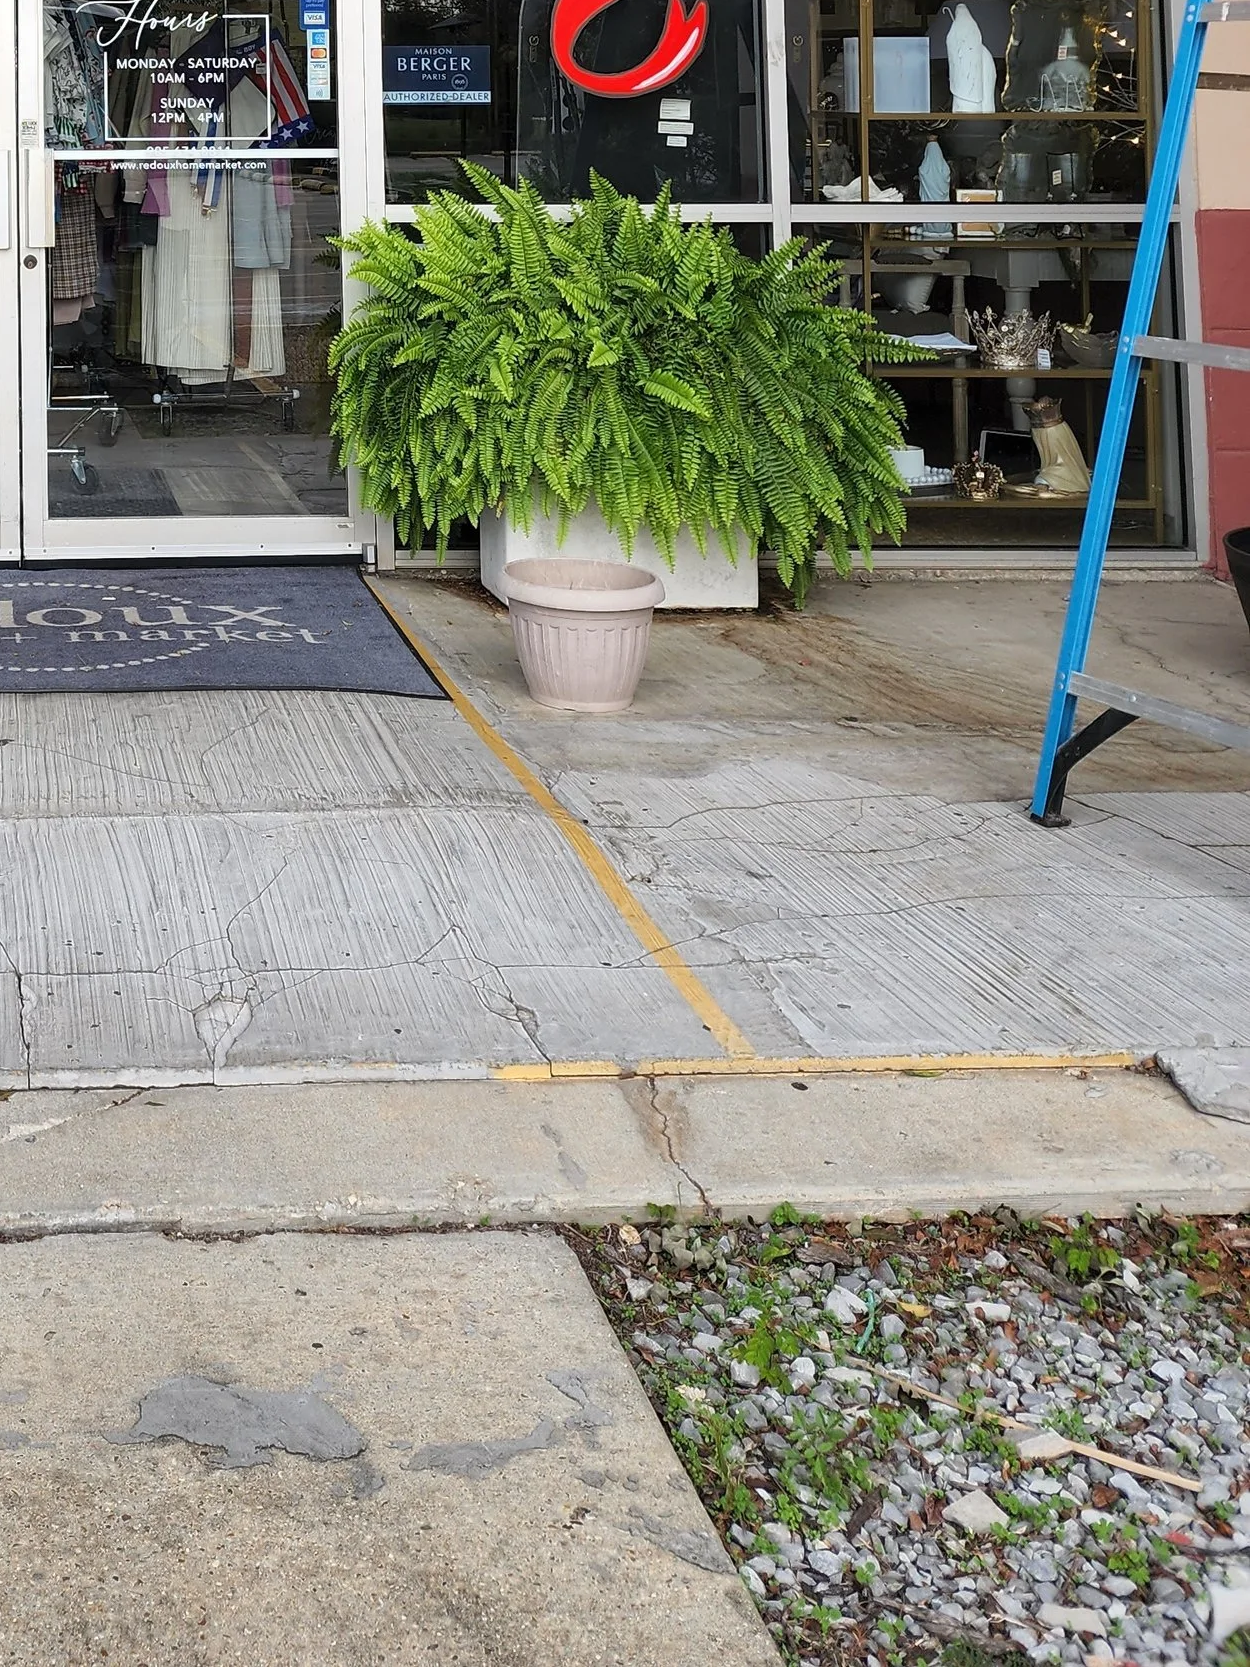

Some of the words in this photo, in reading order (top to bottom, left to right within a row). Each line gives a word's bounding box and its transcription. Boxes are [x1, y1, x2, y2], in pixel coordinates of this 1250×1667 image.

[415, 47, 452, 55] MAISON
[116, 58, 176, 69] MONDAY
[187, 57, 257, 69] SATURDAY
[397, 57, 471, 71] BERGER
[150, 72, 185, 84] 10AM
[198, 72, 225, 84] 6PM
[421, 73, 447, 81] PARIS
[160, 98, 215, 109] SUNDAY
[151, 112, 185, 124] 12PM
[197, 112, 225, 124] 4PM
[110, 160, 267, 171] www.redouxhomemarket.com
[65, 626, 326, 645] market
